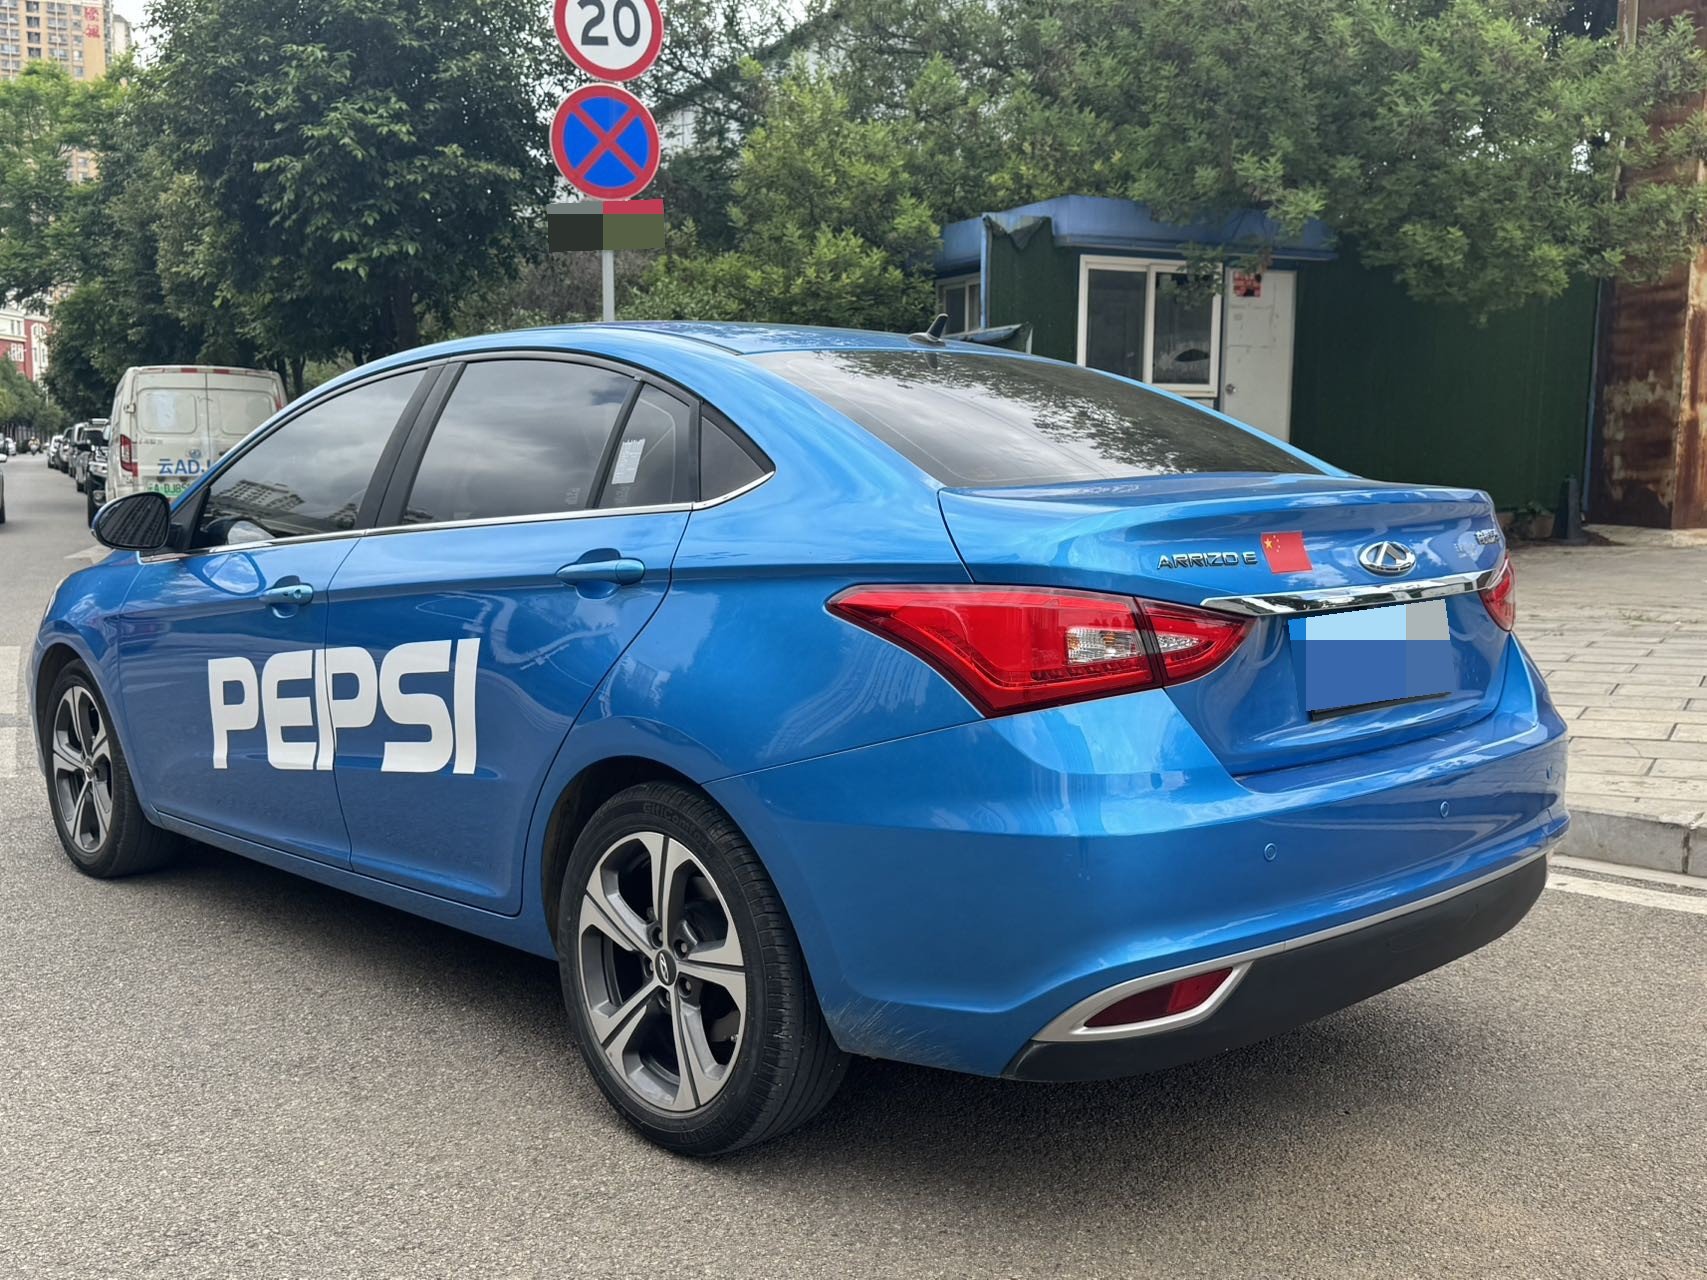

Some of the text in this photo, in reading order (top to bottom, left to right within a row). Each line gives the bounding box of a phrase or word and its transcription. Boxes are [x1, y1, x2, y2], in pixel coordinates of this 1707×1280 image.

[577, 0, 641, 47] 20
[1157, 551, 1258, 570] ARRIZO E
[208, 638, 480, 775] PEPSI
